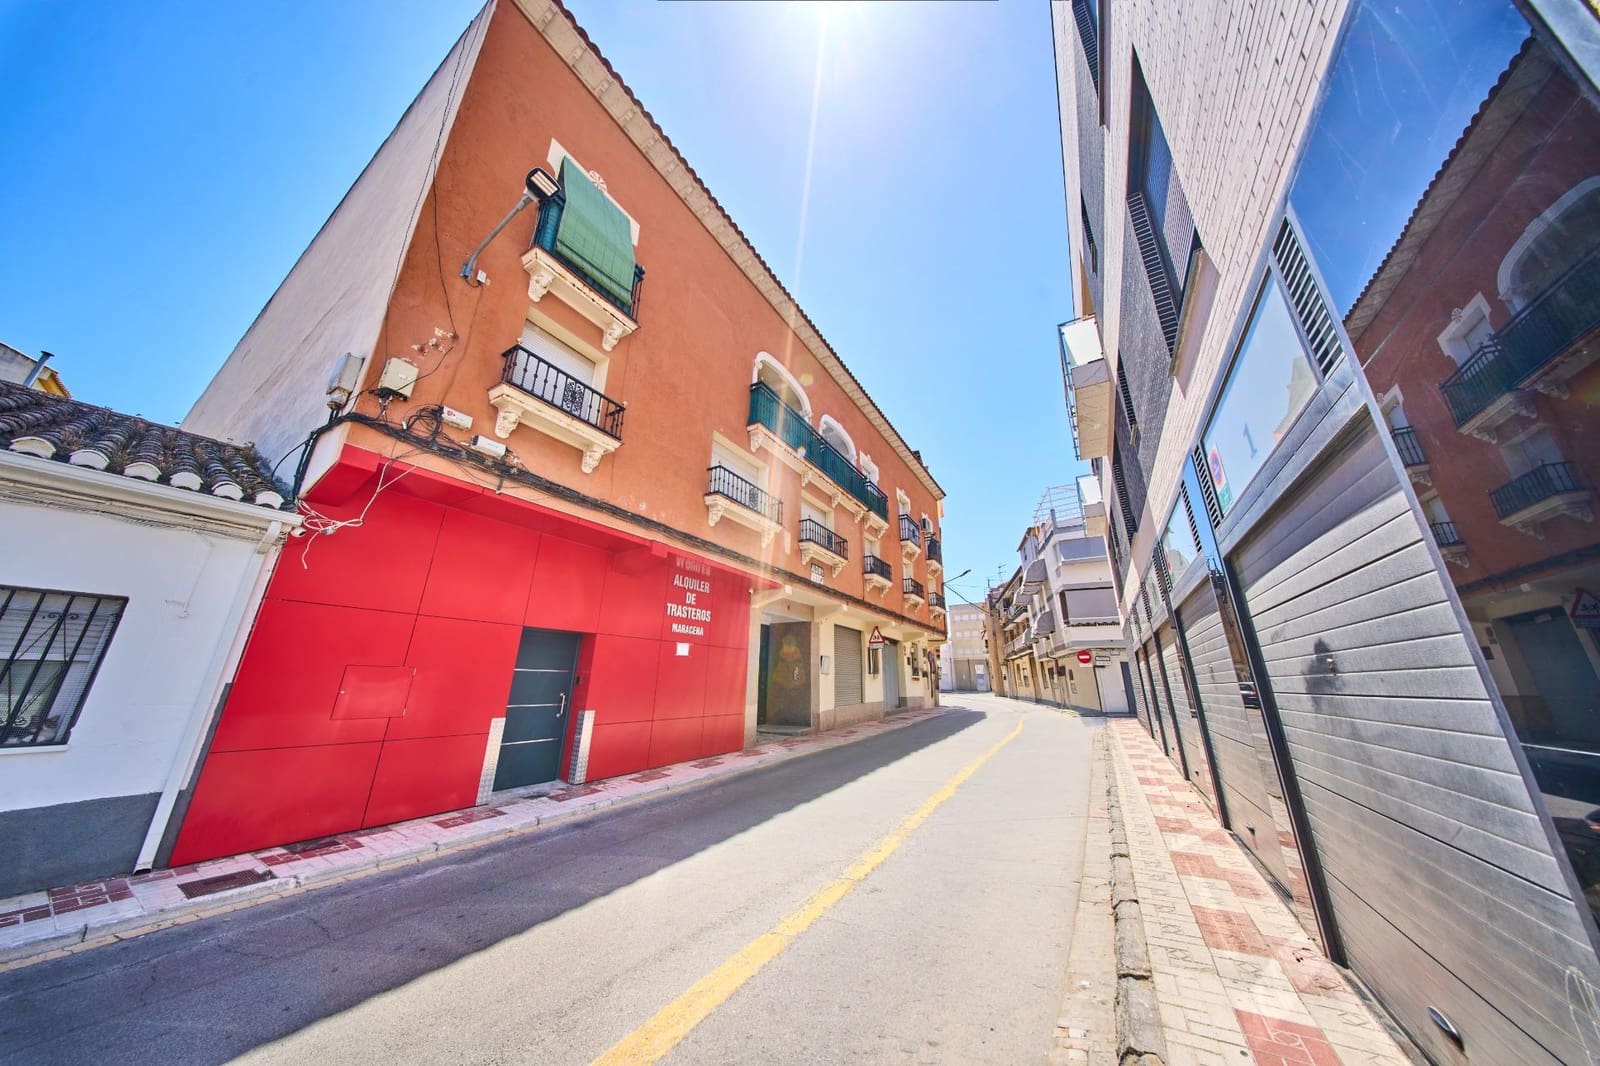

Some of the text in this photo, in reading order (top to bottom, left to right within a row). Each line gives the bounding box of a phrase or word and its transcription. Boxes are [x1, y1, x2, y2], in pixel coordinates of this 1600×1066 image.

[673, 574, 710, 593] ALQUILER
[686, 591, 697, 605] DE
[666, 603, 711, 622] TRASTEROS
[671, 623, 704, 636] MARACENA
